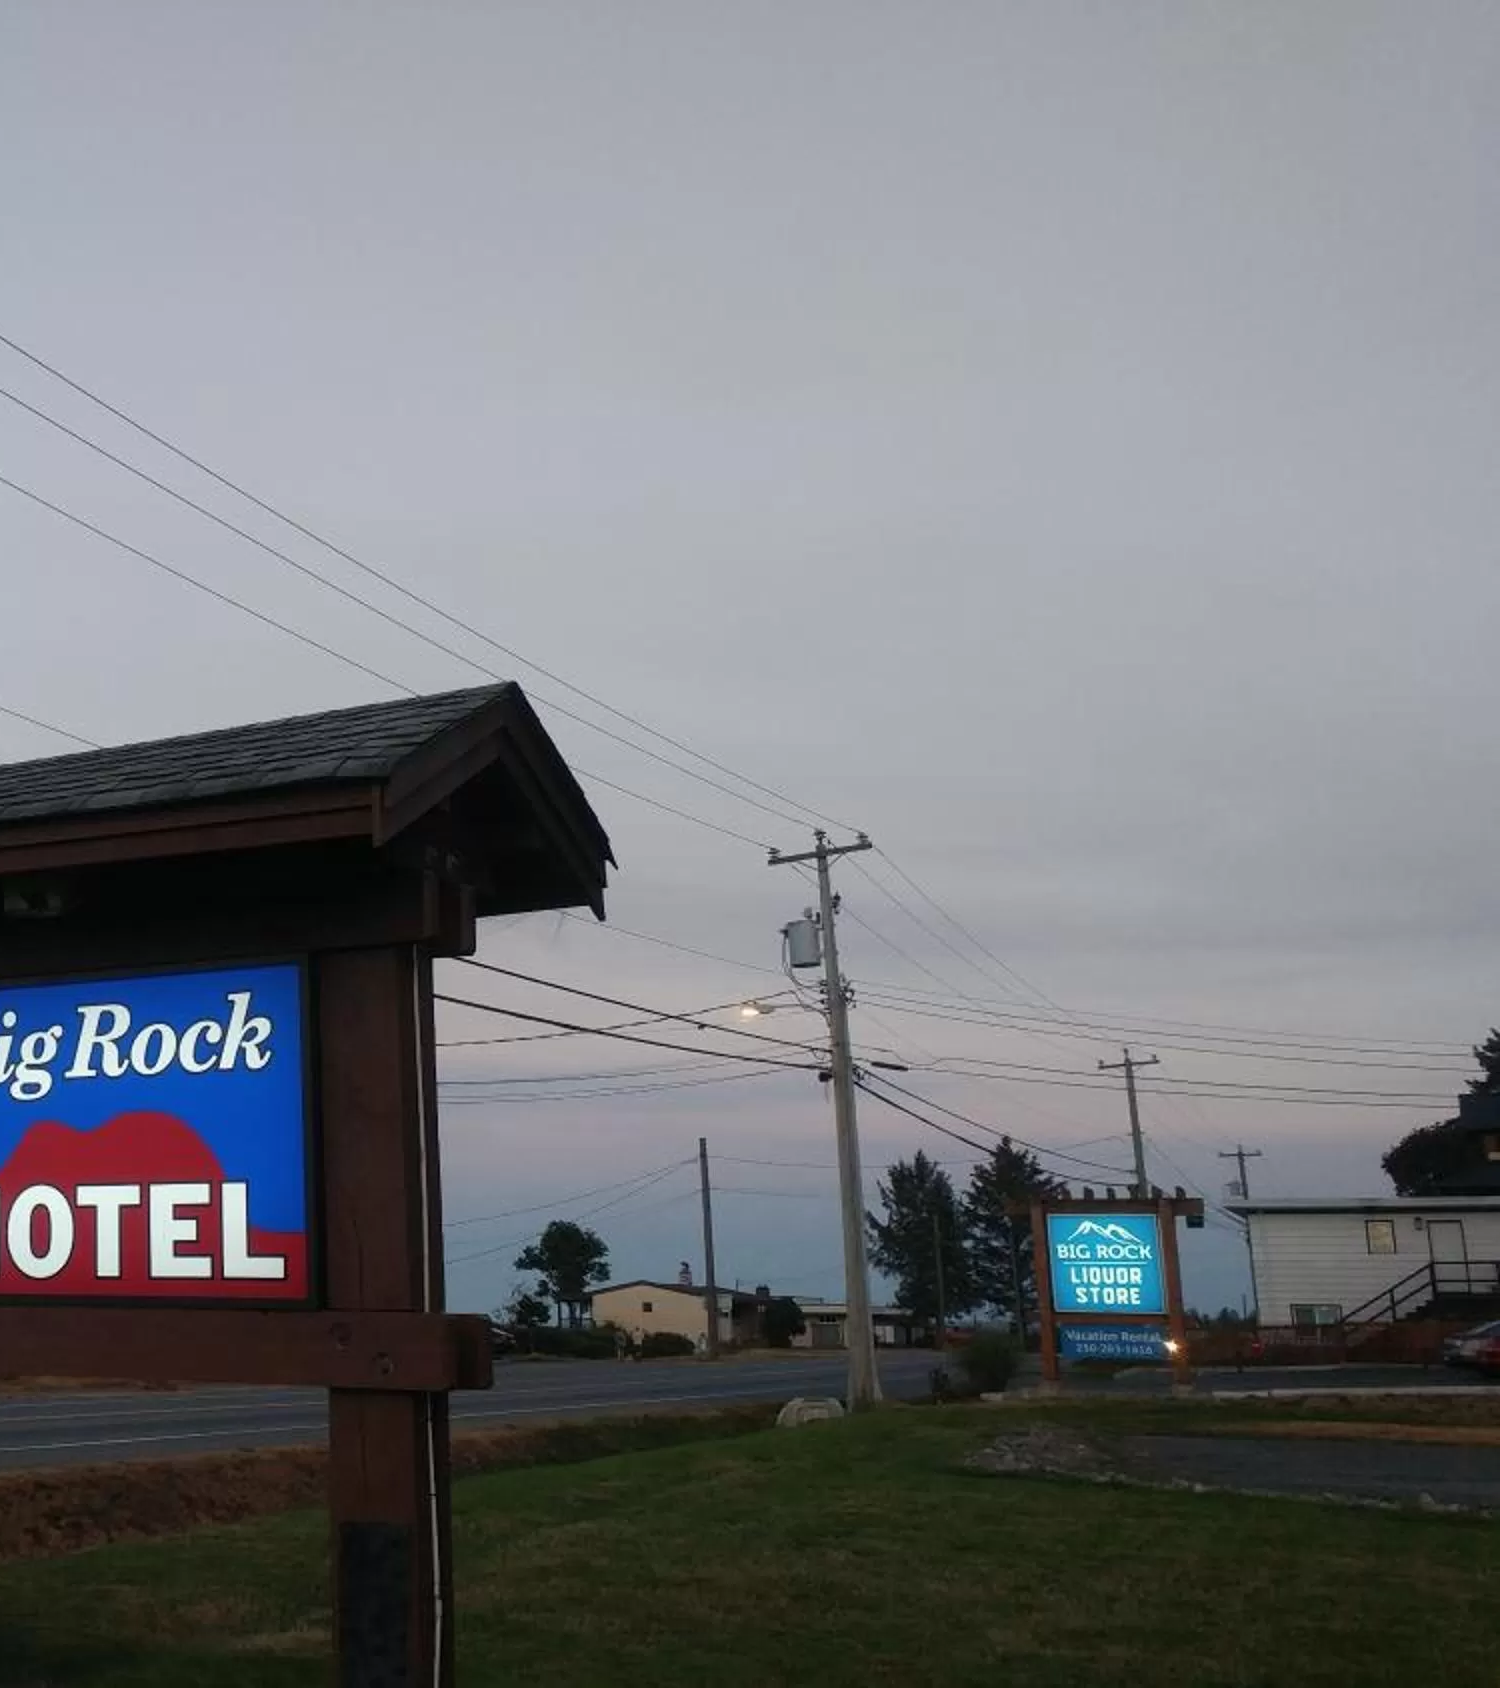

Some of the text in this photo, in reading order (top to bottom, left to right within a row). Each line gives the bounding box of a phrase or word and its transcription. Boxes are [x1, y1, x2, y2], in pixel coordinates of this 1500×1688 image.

[64, 991, 273, 1079] Rock
[1057, 1244, 1152, 1259] BIG ROCK
[1070, 1267, 1142, 1285] LIQUOR
[1075, 1287, 1141, 1305] STORE
[1065, 1329, 1118, 1342] Vacation
